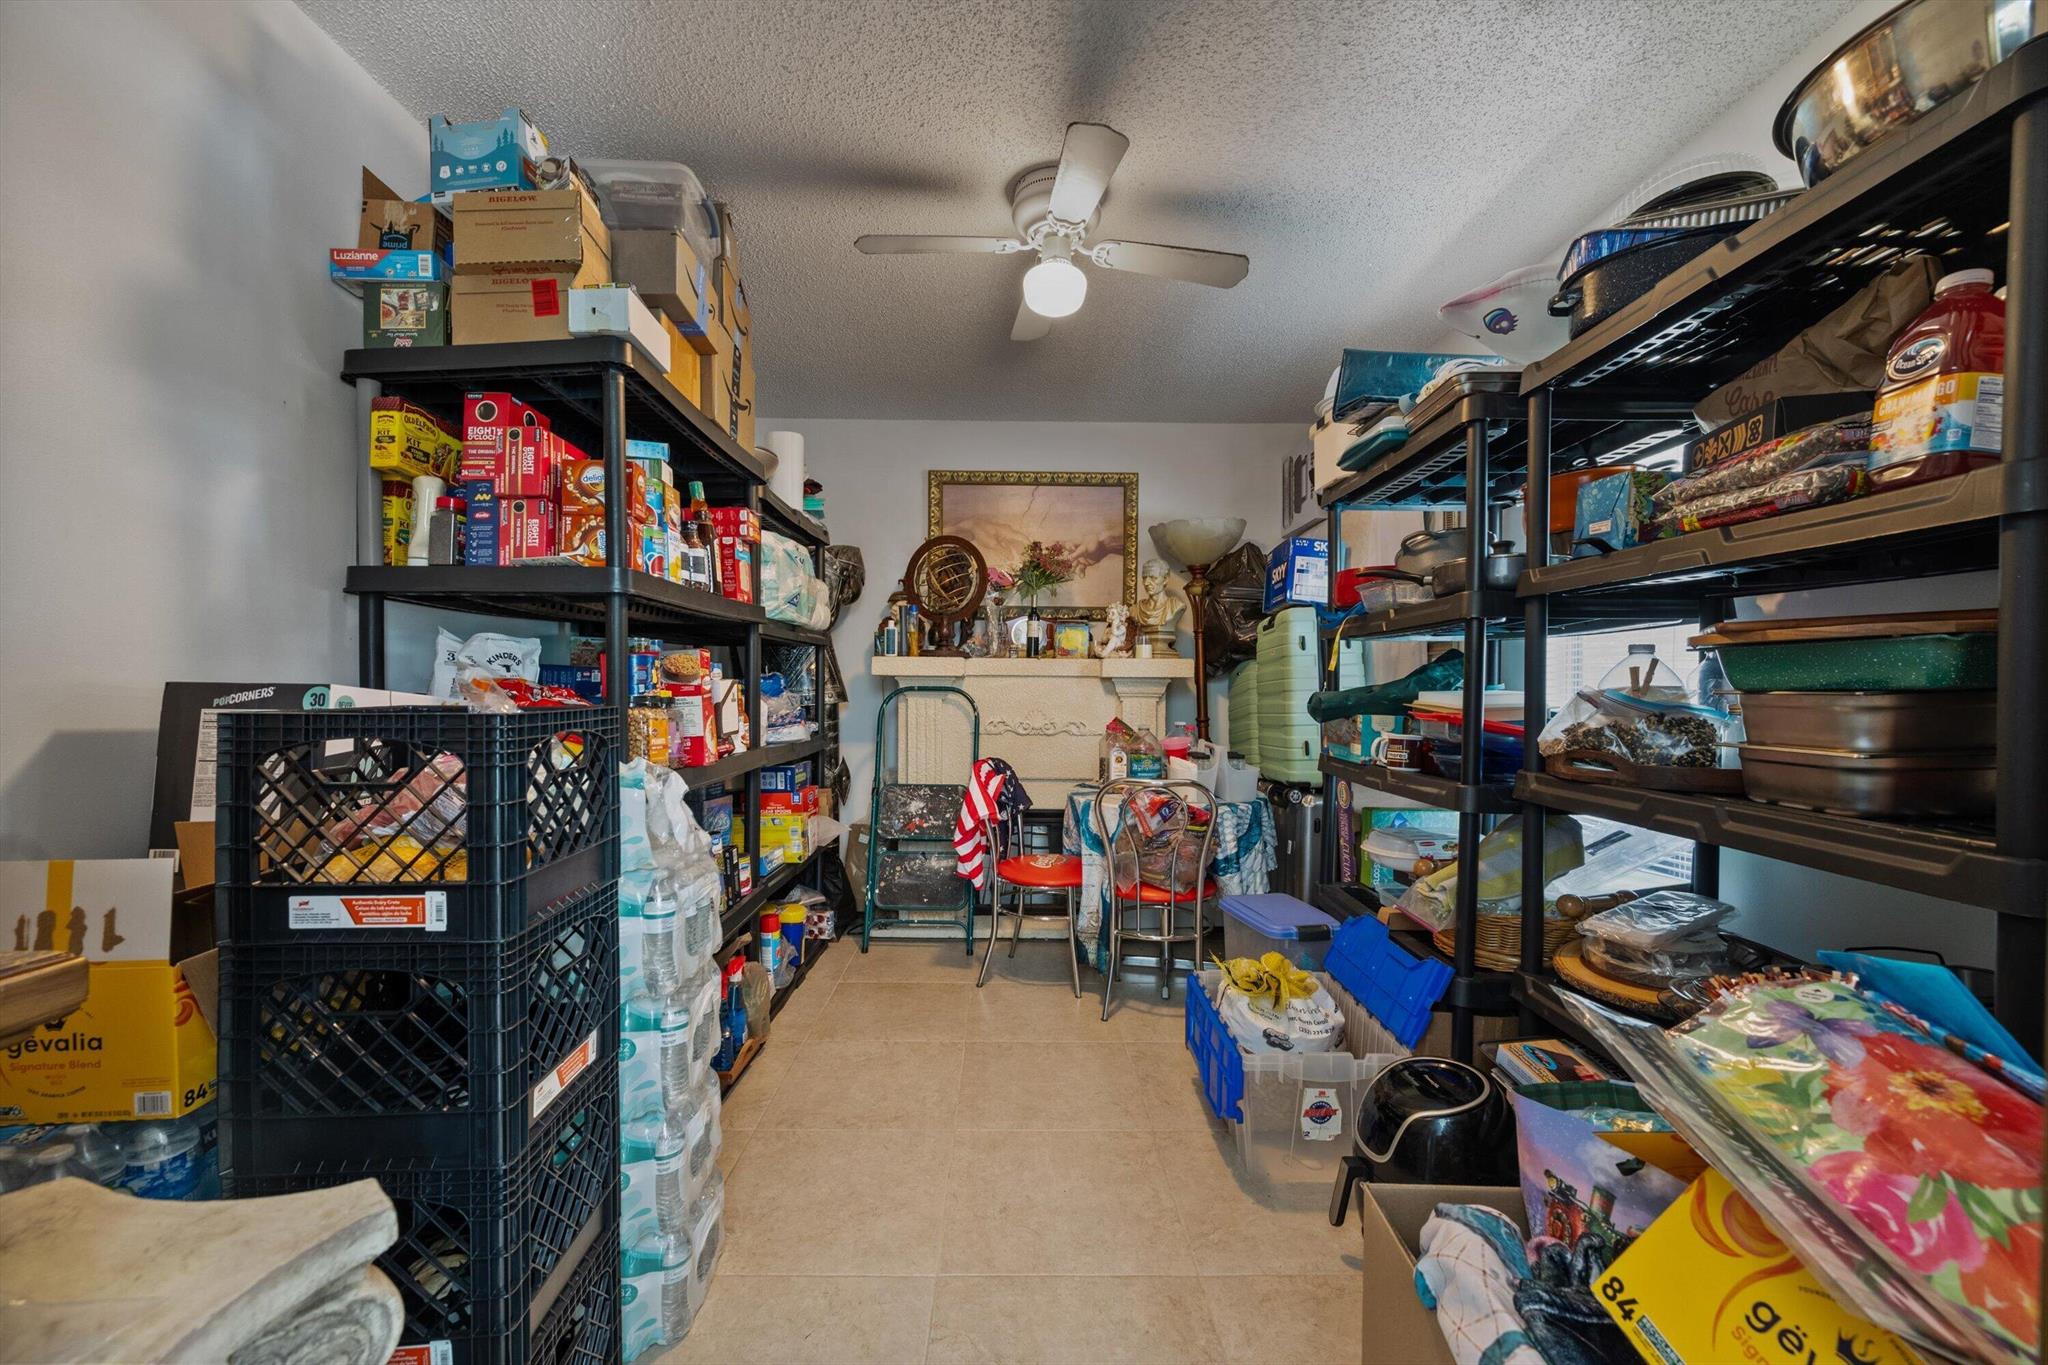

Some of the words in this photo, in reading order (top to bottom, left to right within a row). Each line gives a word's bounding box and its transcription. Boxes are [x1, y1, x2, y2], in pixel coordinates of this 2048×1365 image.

[489, 195, 537, 203] BIGELOW
[383, 241, 408, 249] prime
[333, 251, 379, 261] Luzianne
[1896, 357, 1916, 370] Ocean
[407, 436, 421, 448] KIT
[527, 447, 535, 472] EIGHT
[399, 520, 409, 528] KI
[1314, 541, 1328, 552] SK
[1272, 562, 1287, 585] SKYY
[212, 686, 275, 707] POPCORNERS
[310, 693, 325, 707] 30
[1342, 843, 1352, 882] CUCUM
[9, 1061, 66, 1074] Signature
[69, 1060, 102, 1070] Blend
[184, 1083, 208, 1108] 84
[1601, 1276, 1638, 1323] 84
